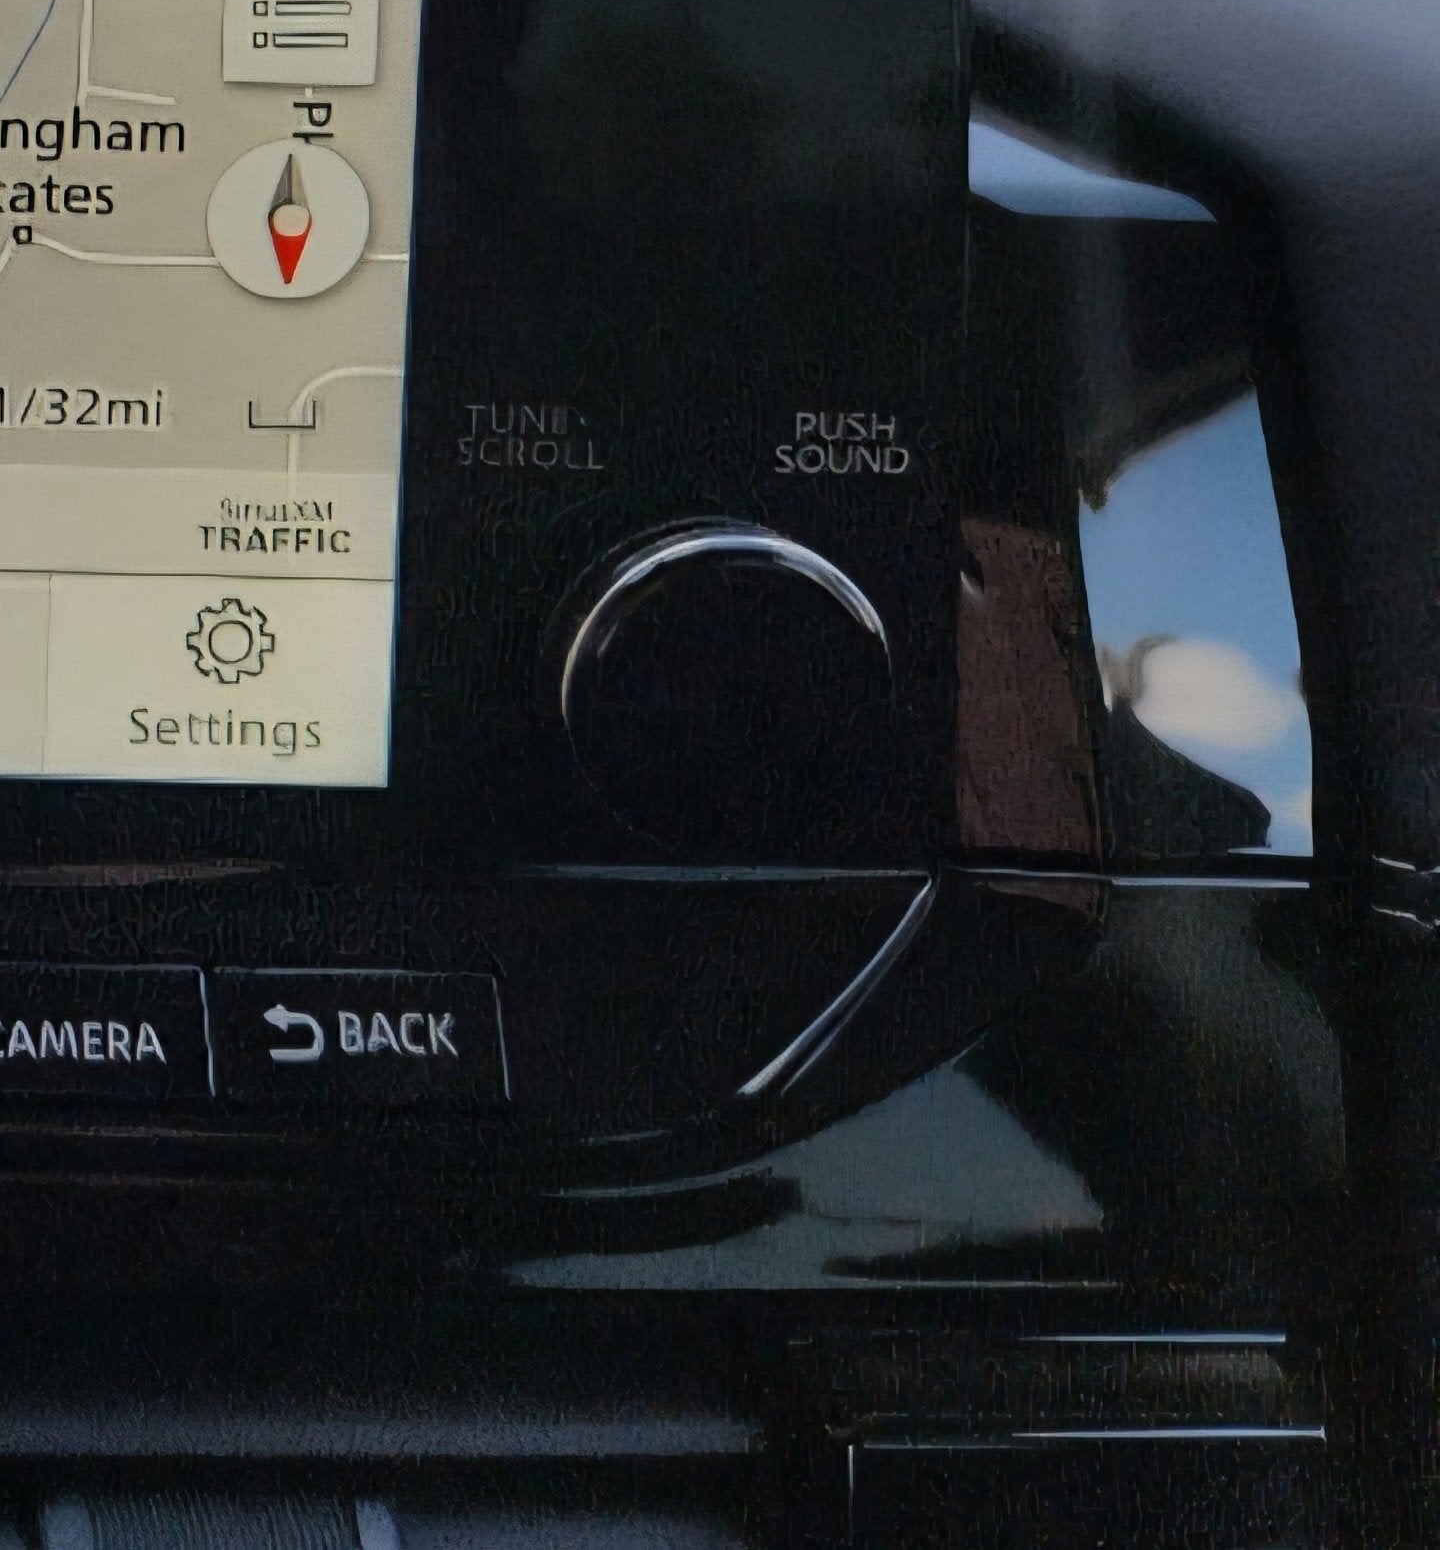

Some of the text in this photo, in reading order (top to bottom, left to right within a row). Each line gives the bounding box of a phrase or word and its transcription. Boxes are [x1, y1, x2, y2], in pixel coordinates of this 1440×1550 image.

[795, 410, 897, 442] PUSH
[774, 444, 911, 475] SOUND
[198, 525, 351, 554] TRAFFIC
[129, 707, 322, 757] Settings
[337, 1010, 460, 1057] BACK
